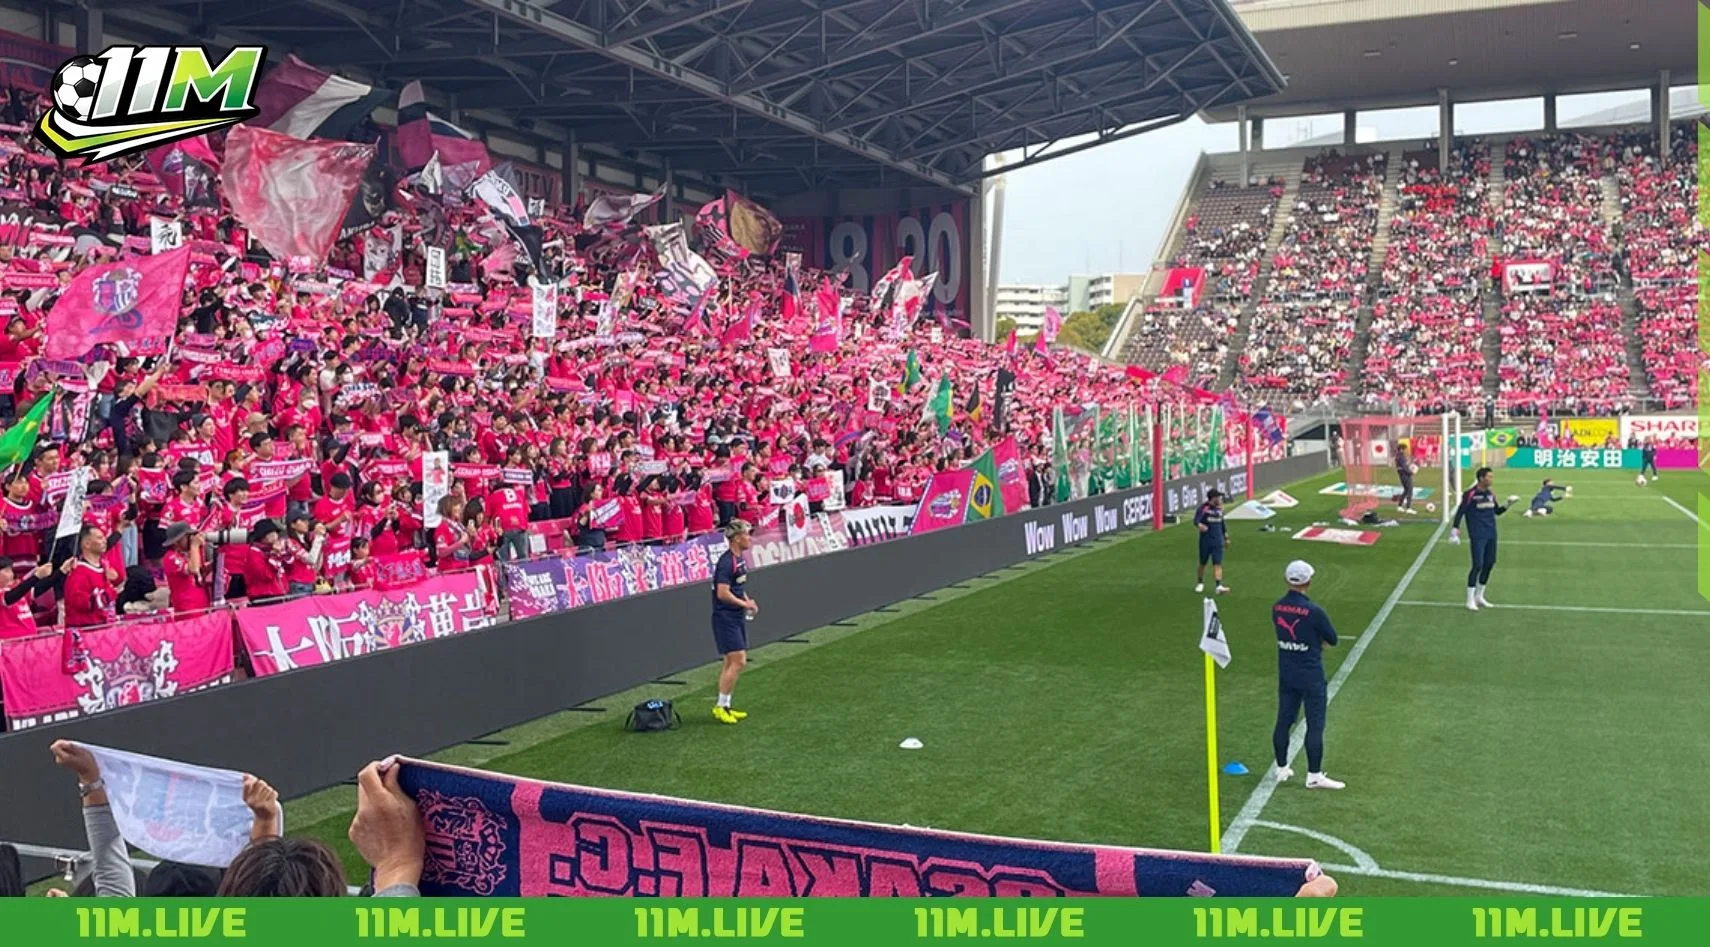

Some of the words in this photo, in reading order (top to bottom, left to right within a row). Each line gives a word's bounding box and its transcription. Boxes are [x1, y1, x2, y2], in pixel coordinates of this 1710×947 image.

[1534, 450, 1623, 468] 明治安田
[1024, 520, 1055, 555] Wow
[1062, 512, 1089, 544] Wow
[1094, 505, 1118, 534] Wow
[1123, 493, 1154, 525] CEREZ
